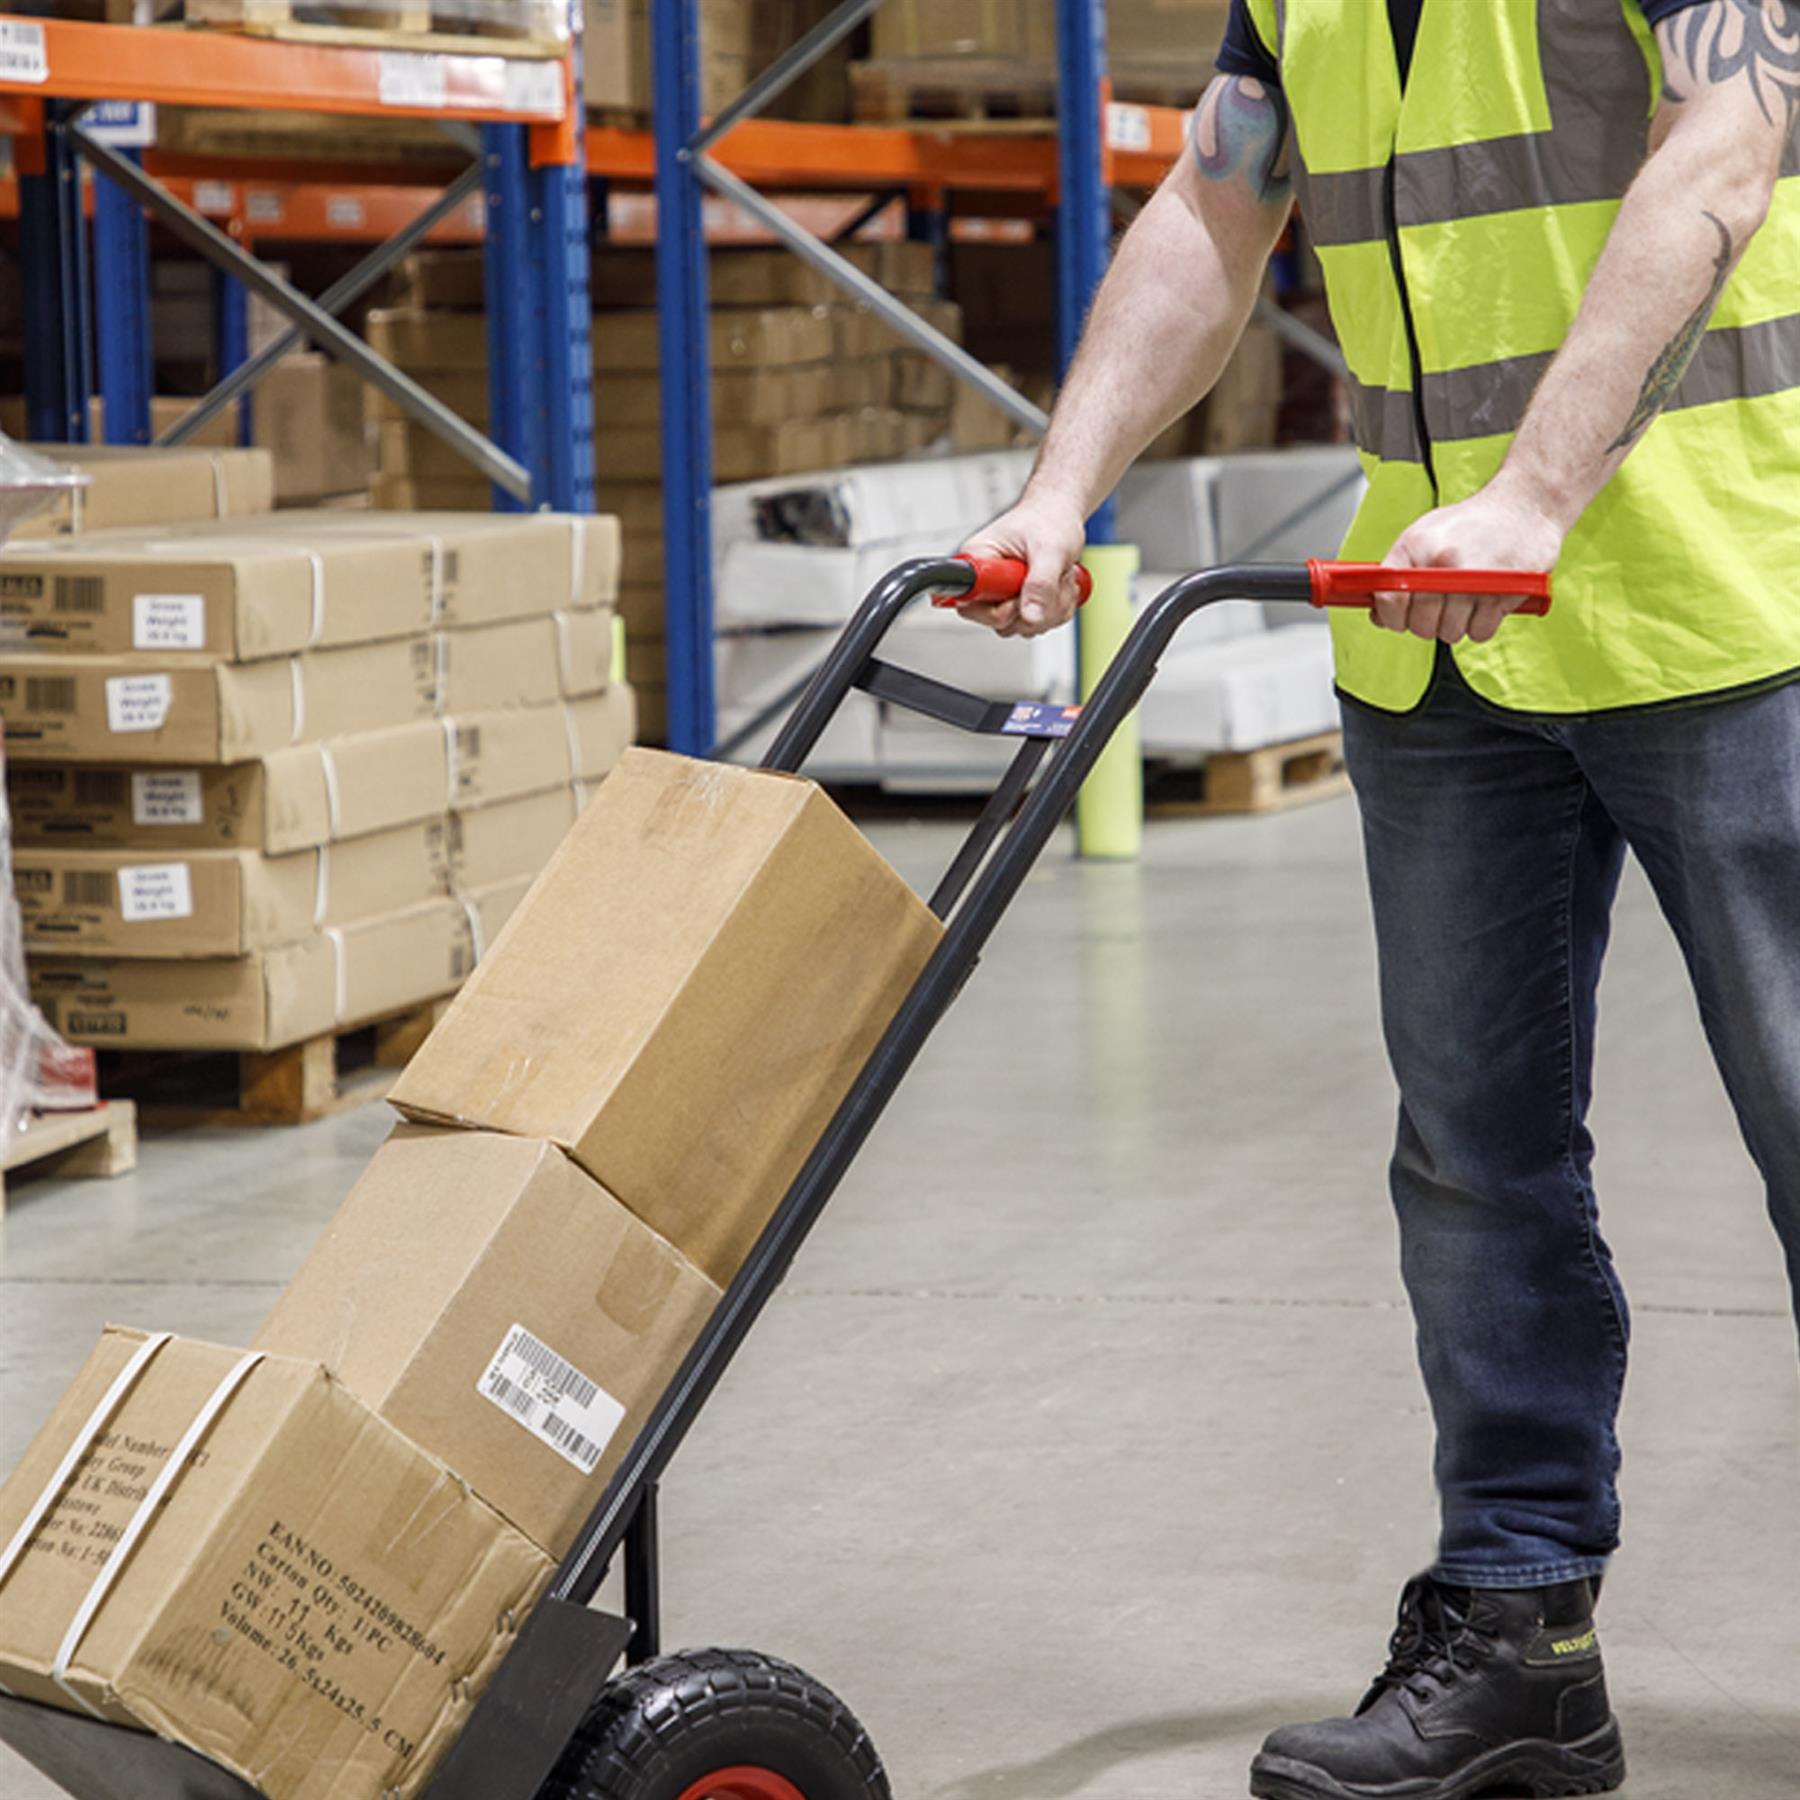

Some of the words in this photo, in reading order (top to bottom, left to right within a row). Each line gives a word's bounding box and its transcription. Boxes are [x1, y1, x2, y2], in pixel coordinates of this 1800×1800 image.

[108, 1457, 147, 1481] Group
[256, 1541, 308, 1589] Carton
[324, 1623, 354, 1655] Kgs
[383, 1729, 414, 1758] CM
